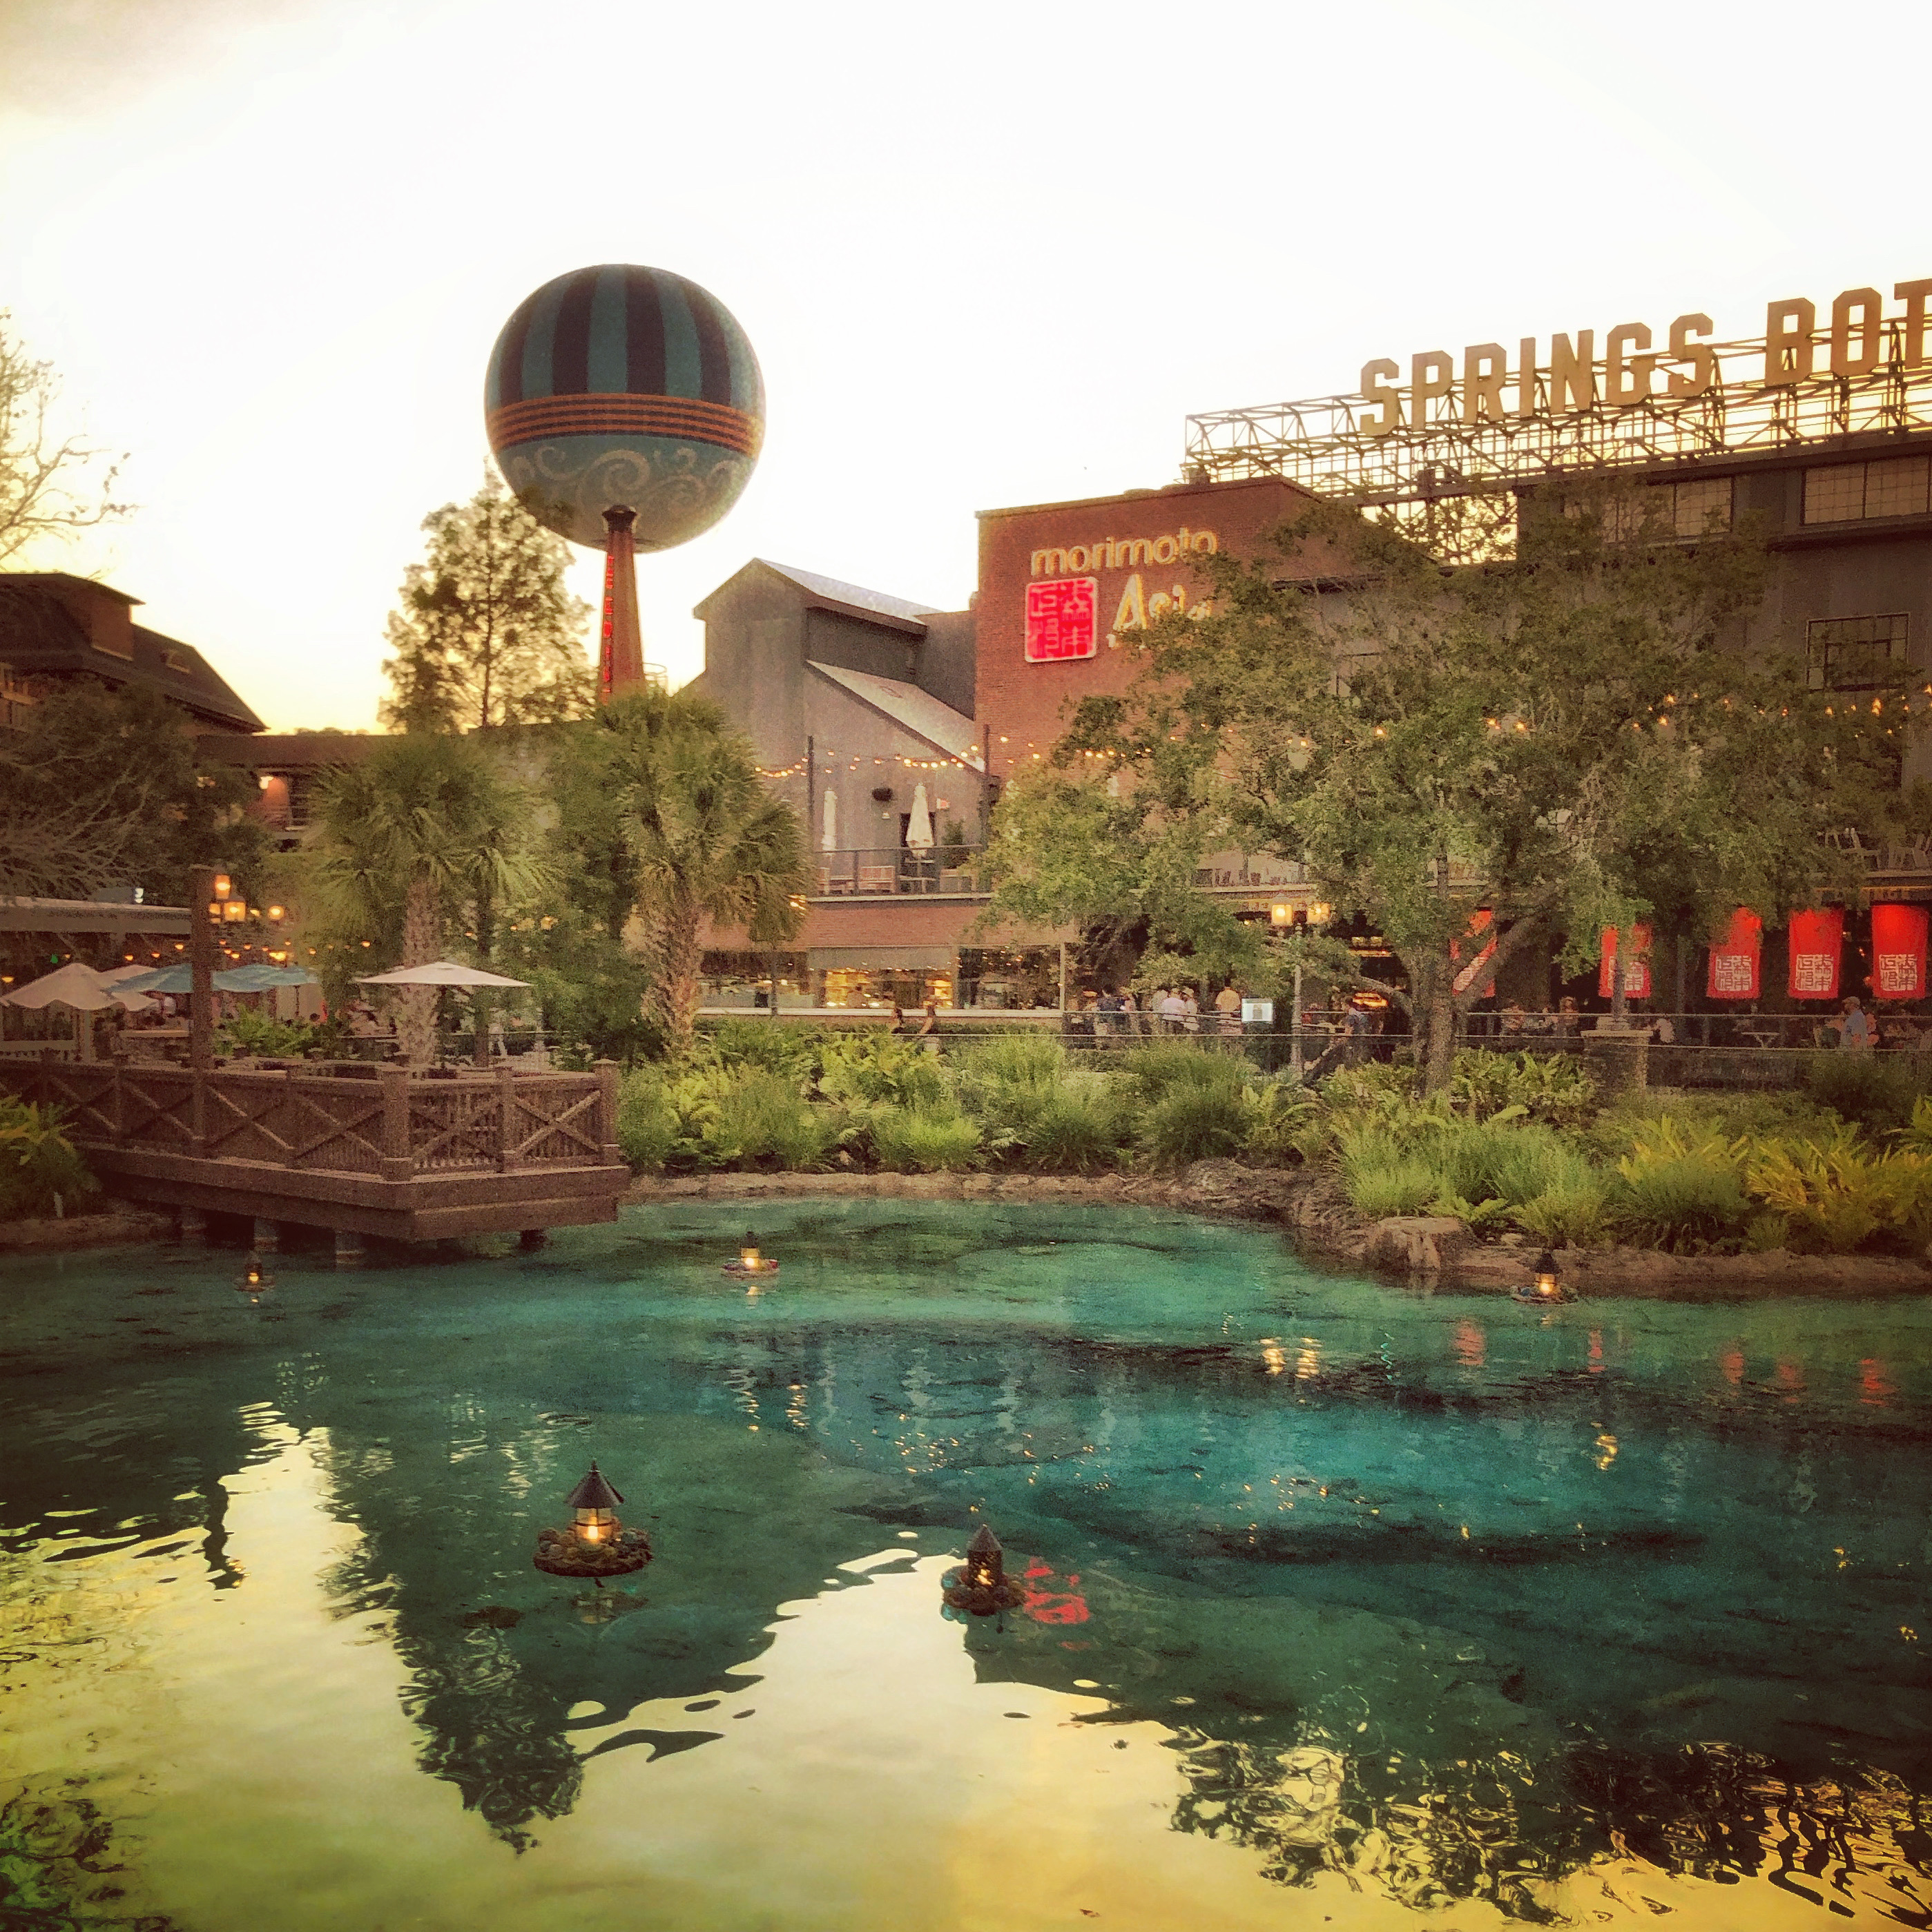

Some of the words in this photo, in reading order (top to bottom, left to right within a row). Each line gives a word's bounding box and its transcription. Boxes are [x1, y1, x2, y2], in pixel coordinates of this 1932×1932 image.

[1360, 312, 1714, 436] SPRINGS
[1765, 278, 1932, 387] BOT
[1030, 526, 1217, 576] morimoto
